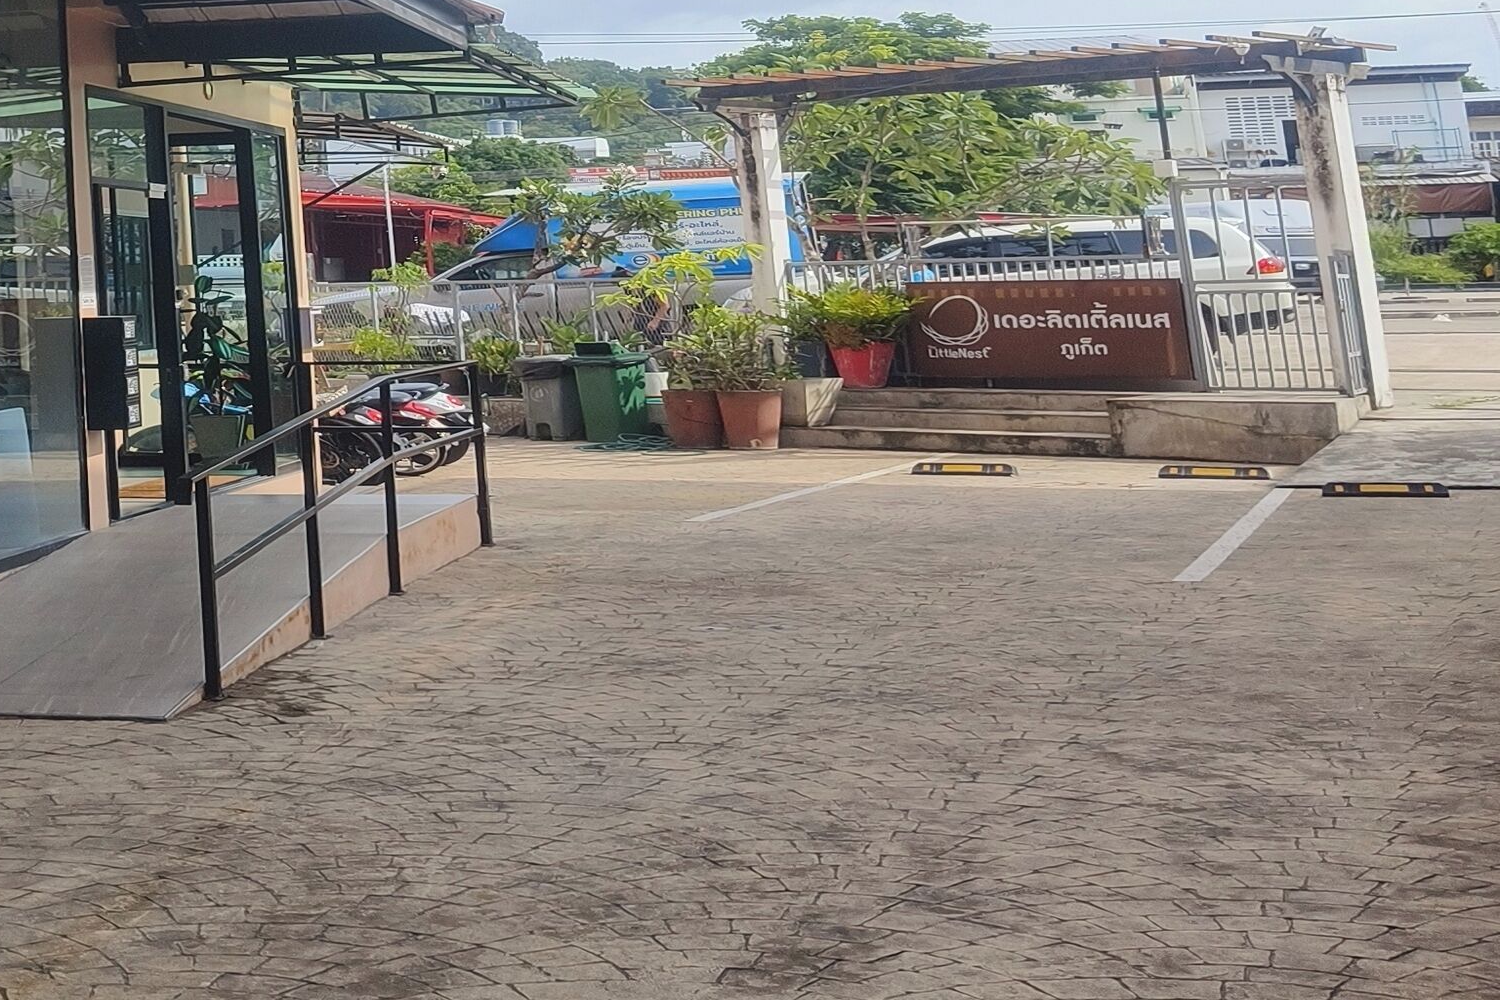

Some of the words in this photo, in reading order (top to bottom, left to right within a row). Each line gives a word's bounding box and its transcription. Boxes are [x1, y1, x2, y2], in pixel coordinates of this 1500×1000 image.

[993, 302, 1171, 329] เดอะลิตเติ้ลเนส
[1060, 337, 1108, 360] ภูเก็ต
